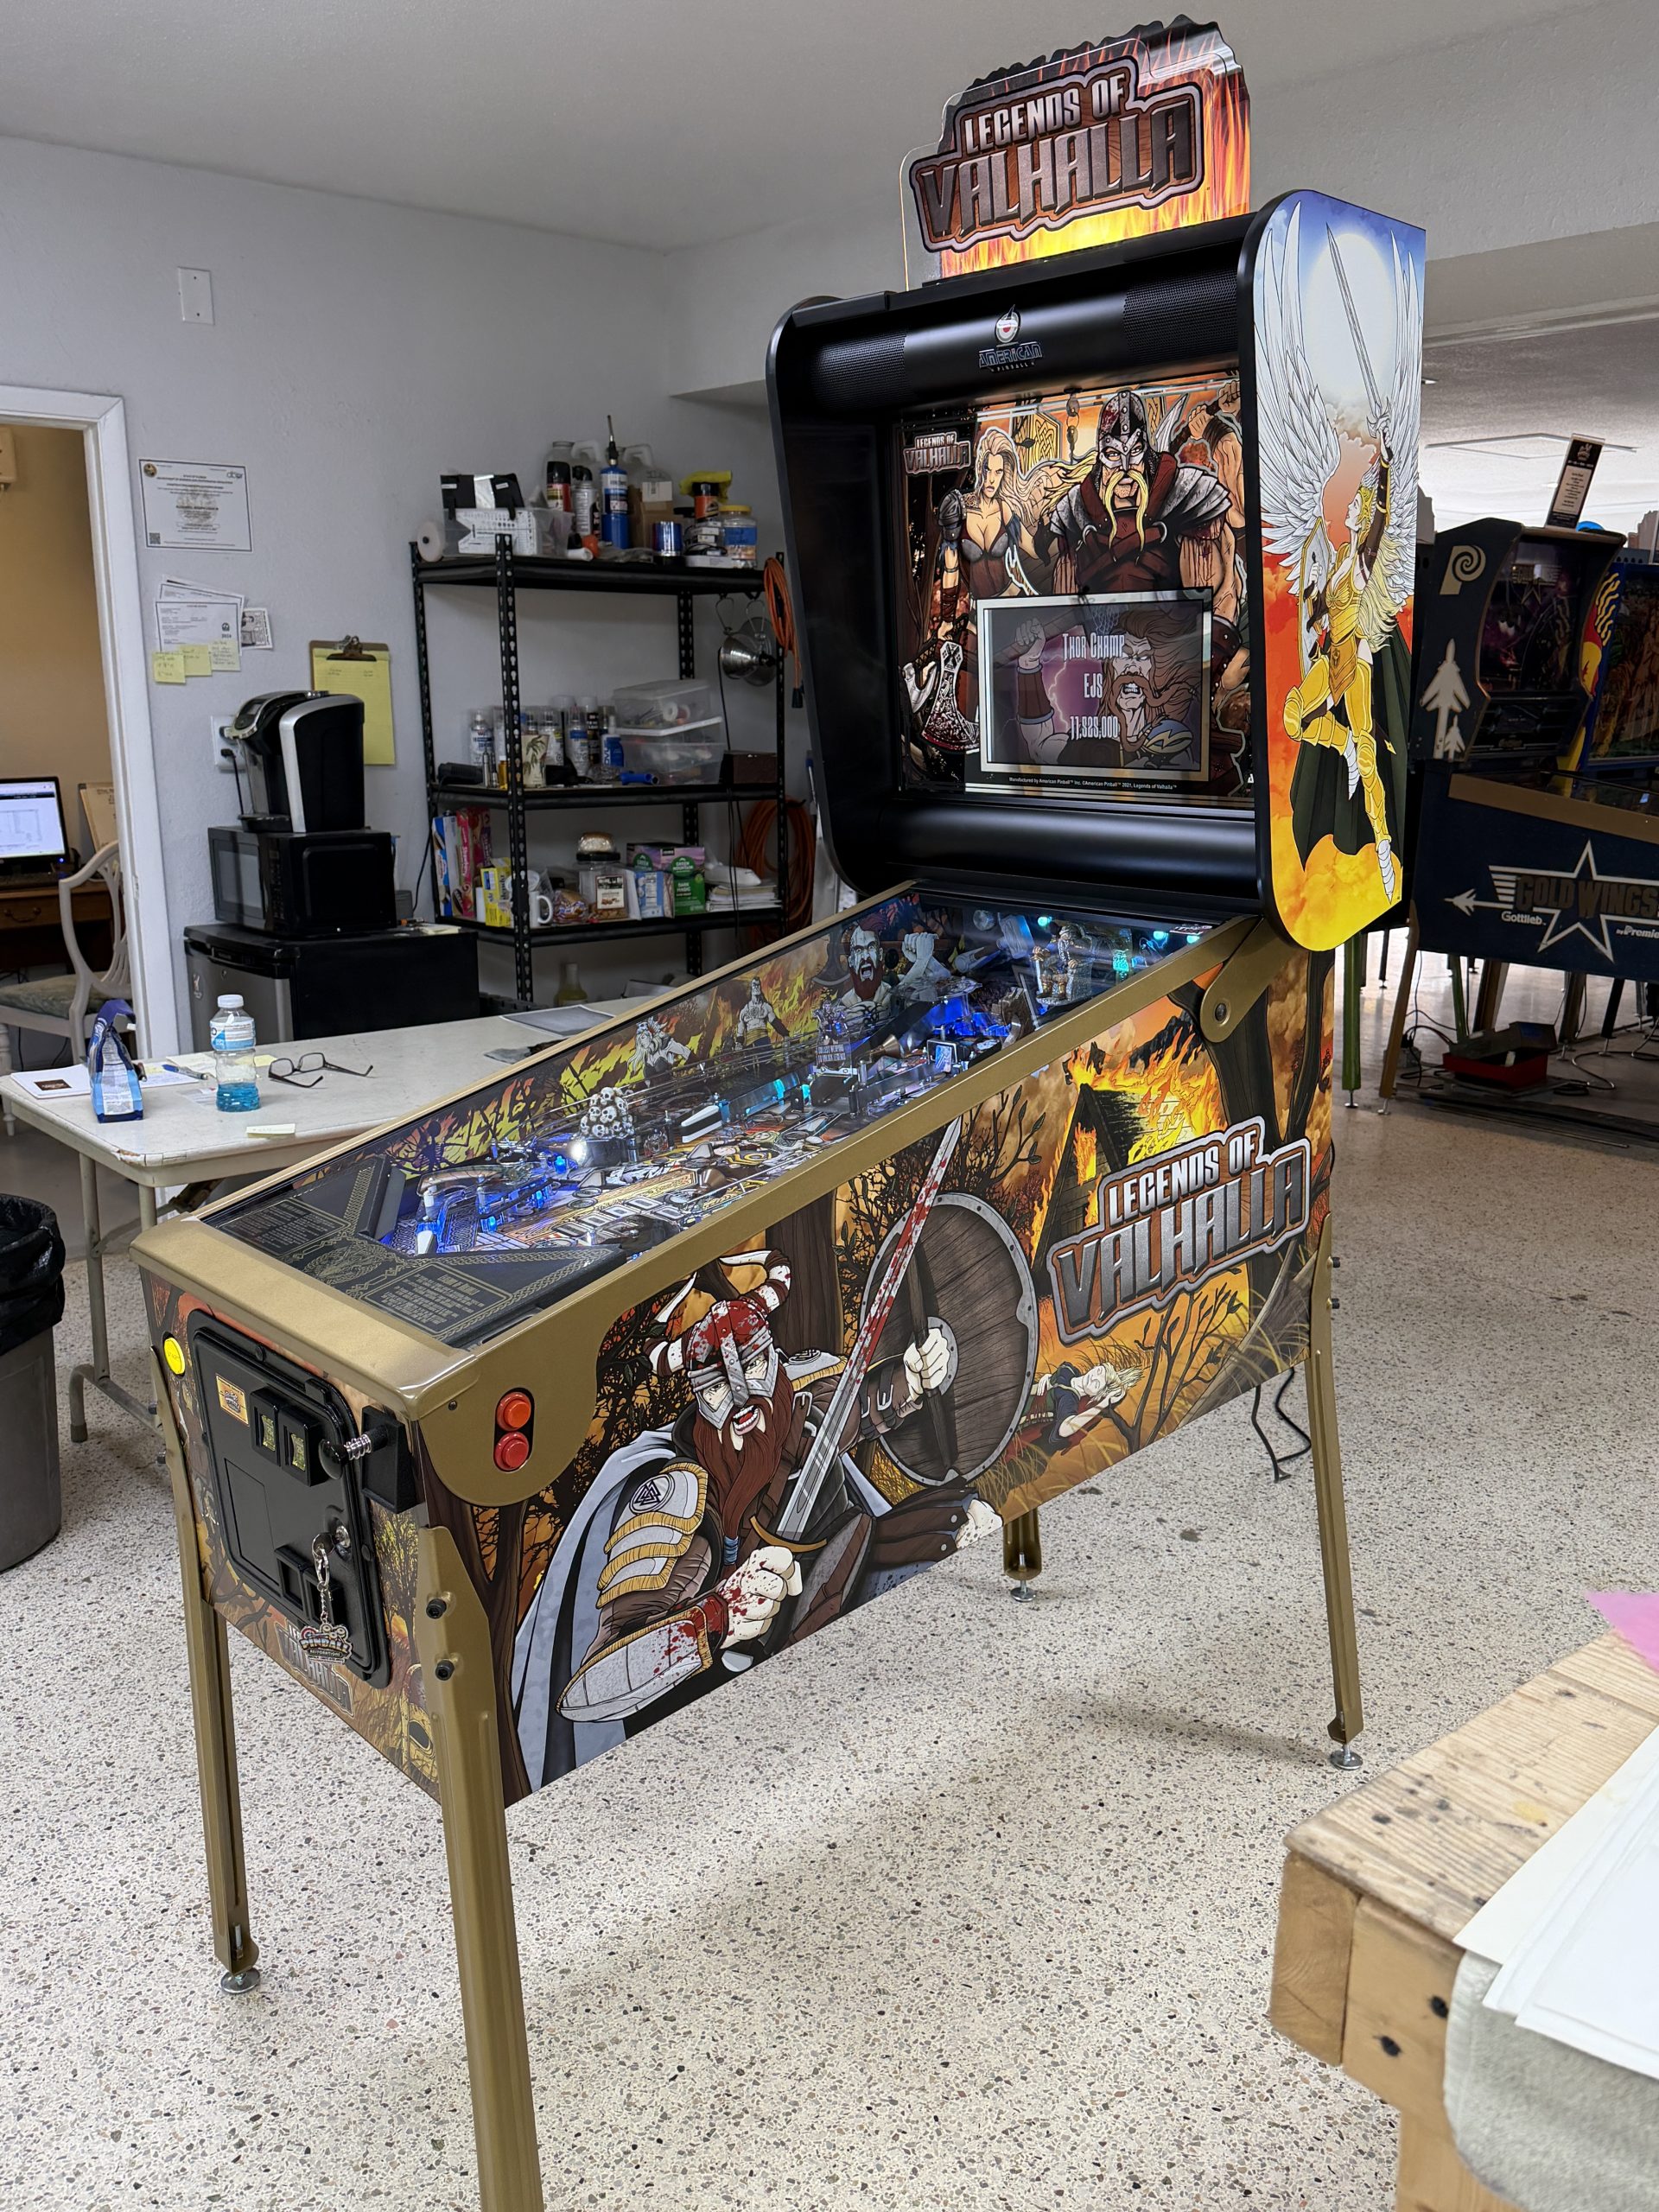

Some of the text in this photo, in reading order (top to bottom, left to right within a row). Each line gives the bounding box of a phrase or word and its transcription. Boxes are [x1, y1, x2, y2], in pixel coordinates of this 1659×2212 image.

[963, 73, 1127, 154] LEGENDS OF
[921, 100, 1192, 238] VALHALLA
[979, 345, 1042, 368] AMERICAN
[997, 362, 1028, 372] PINBALL
[917, 434, 955, 448] LEGENDS OF
[906, 443, 969, 472] VALHALLA
[1084, 673, 1103, 698] EJS
[1070, 715, 1118, 741] 11,525,000
[1516, 874, 1658, 918] GOLD WINGS
[1624, 925, 1659, 939] Premie
[1109, 1129, 1257, 1228] LEGENDS OF
[1058, 1151, 1304, 1328] VALHALLA
[301, 1638, 349, 1653] PINBALL
